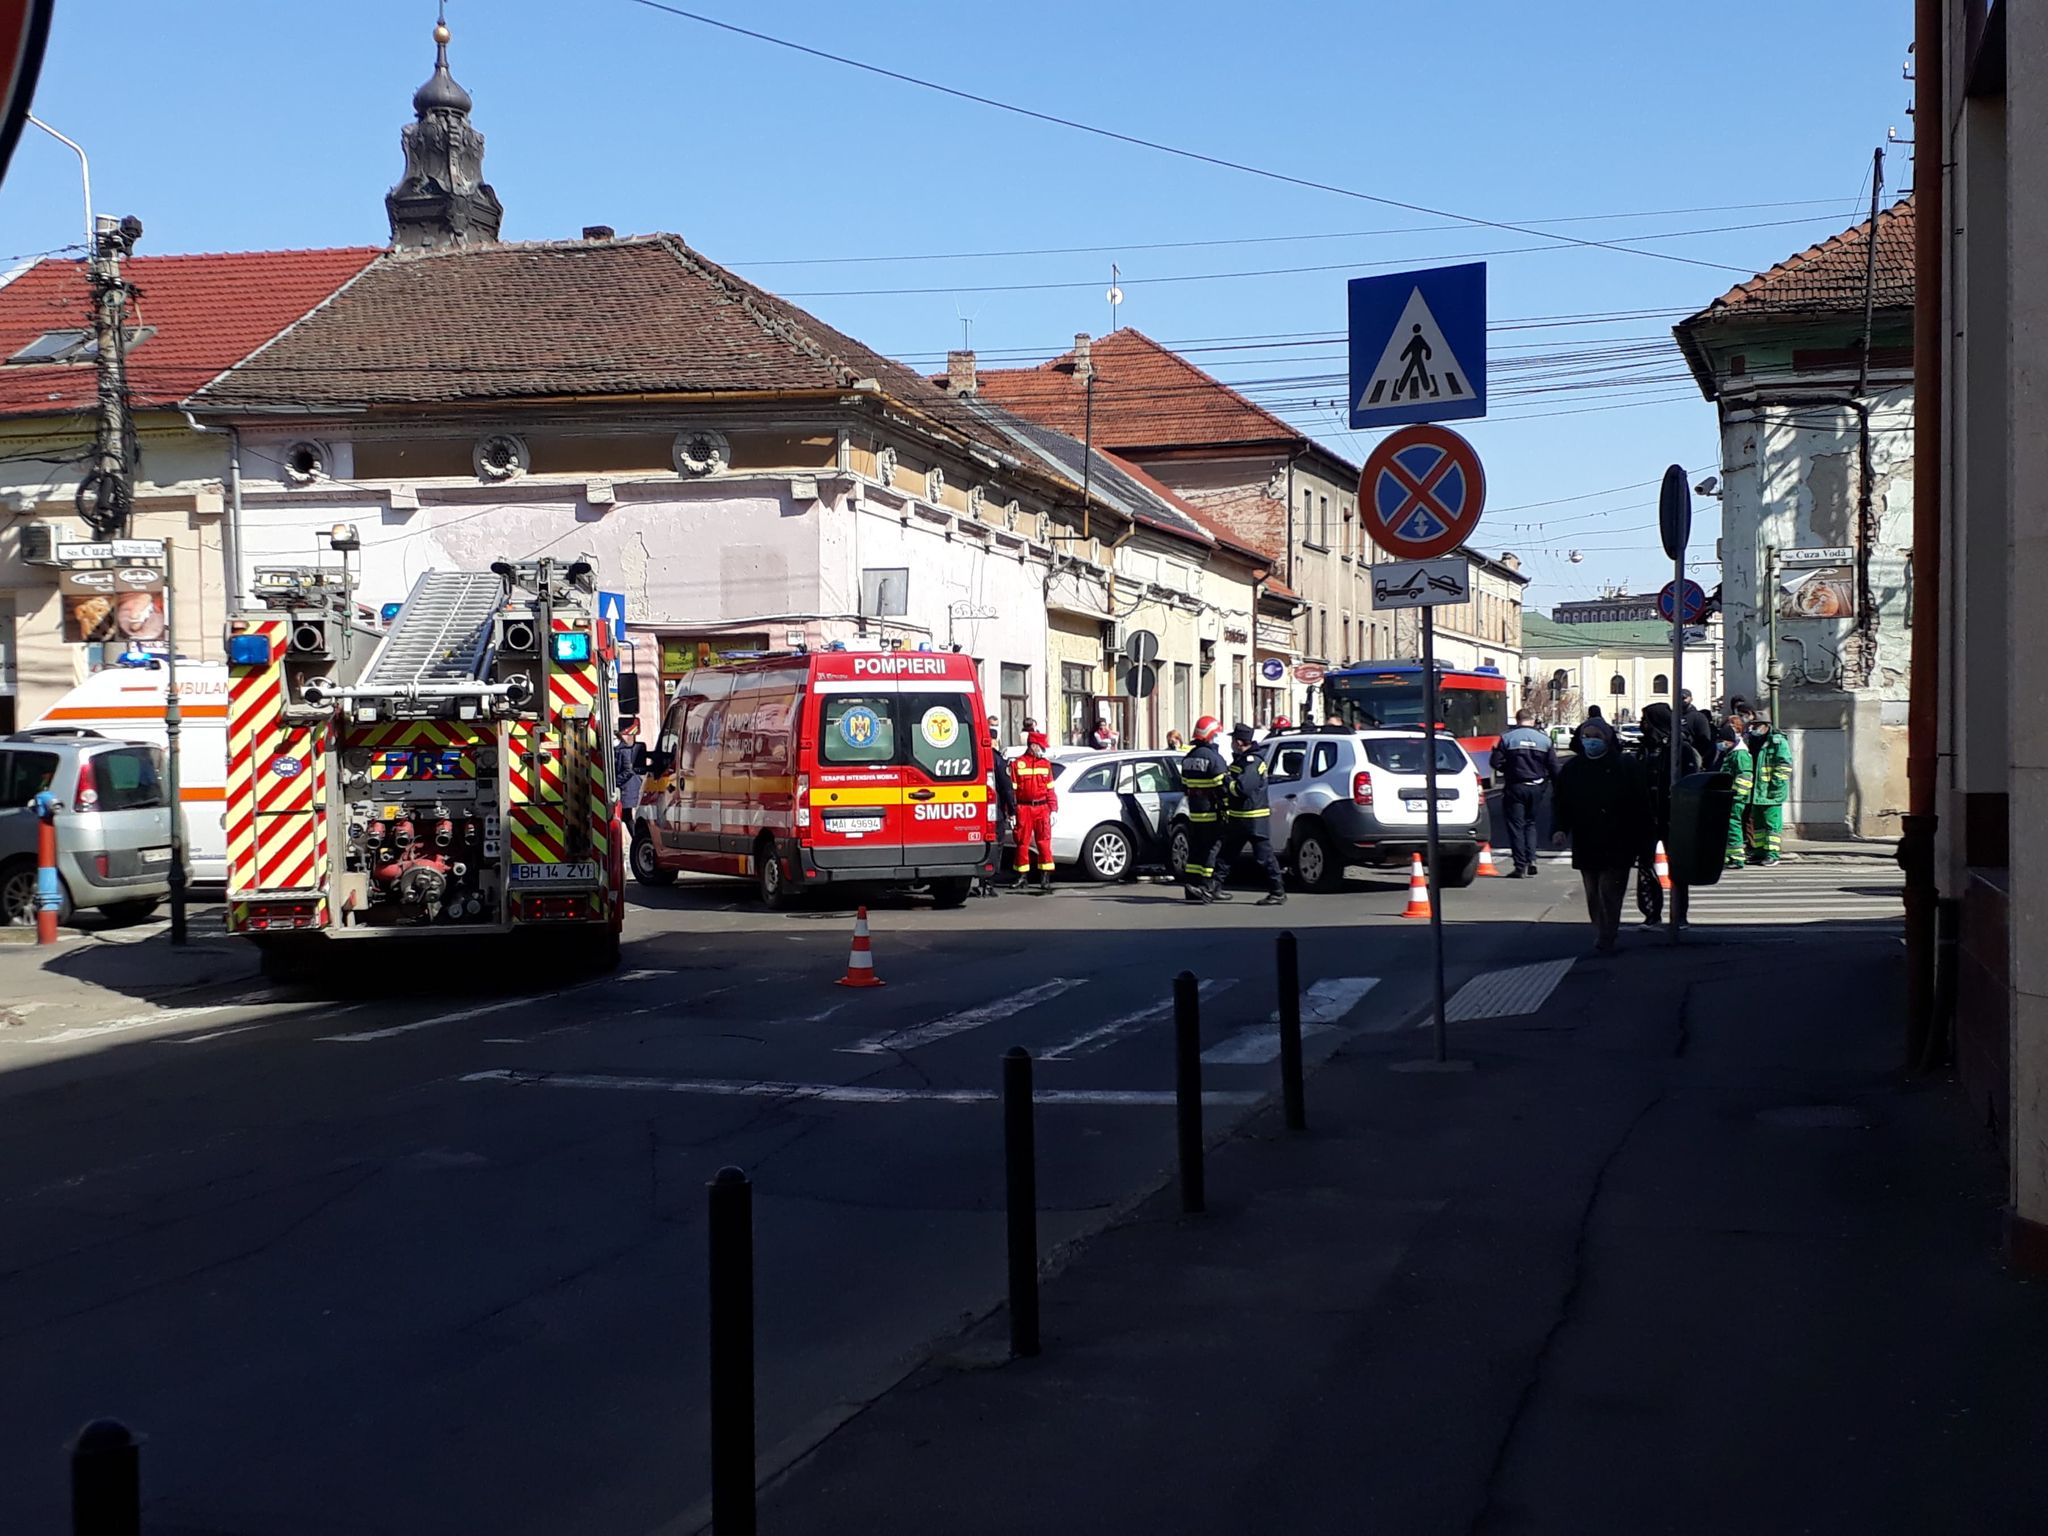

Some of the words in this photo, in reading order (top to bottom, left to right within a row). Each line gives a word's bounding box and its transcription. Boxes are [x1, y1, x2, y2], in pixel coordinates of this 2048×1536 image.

[1796, 550, 1820, 559] Cuza
[854, 658, 946, 675] POMPIERII
[385, 752, 462, 776] FIRE
[914, 803, 978, 821] SMURD
[520, 865, 541, 879] BH
[546, 864, 559, 878] 14
[566, 864, 591, 878] ZYI
